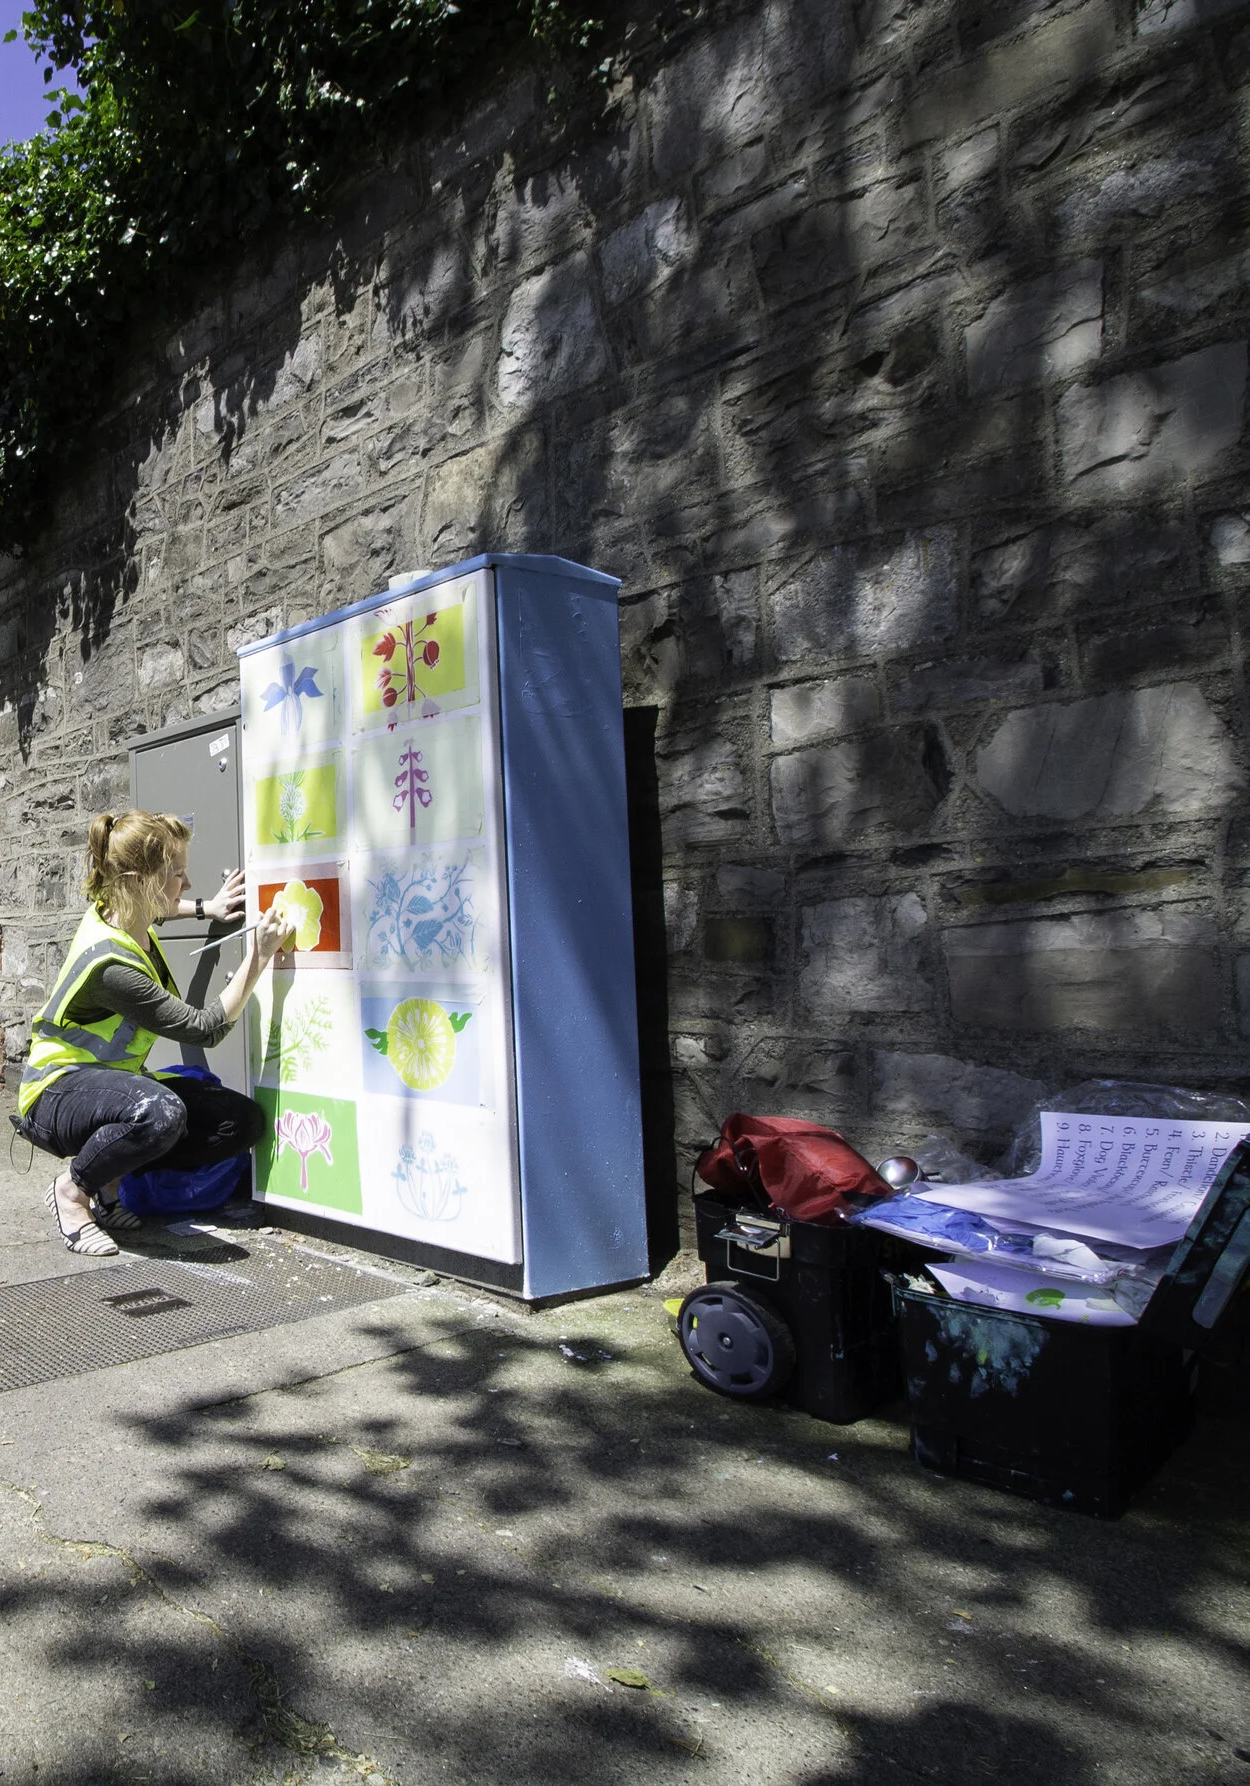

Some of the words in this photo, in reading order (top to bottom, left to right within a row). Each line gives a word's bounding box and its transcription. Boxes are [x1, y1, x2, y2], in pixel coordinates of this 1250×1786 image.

[1057, 1122, 1070, 1132] 9.
[1078, 1123, 1092, 1134] 8.
[1100, 1126, 1114, 1135] 7.
[1123, 1126, 1136, 1137] 6.
[1146, 1128, 1159, 1139] 5.
[1168, 1130, 1182, 1141] 4.
[1191, 1130, 1205, 1141] 3.
[1215, 1132, 1230, 1142] 2.
[1094, 1141, 1114, 1164] Dog
